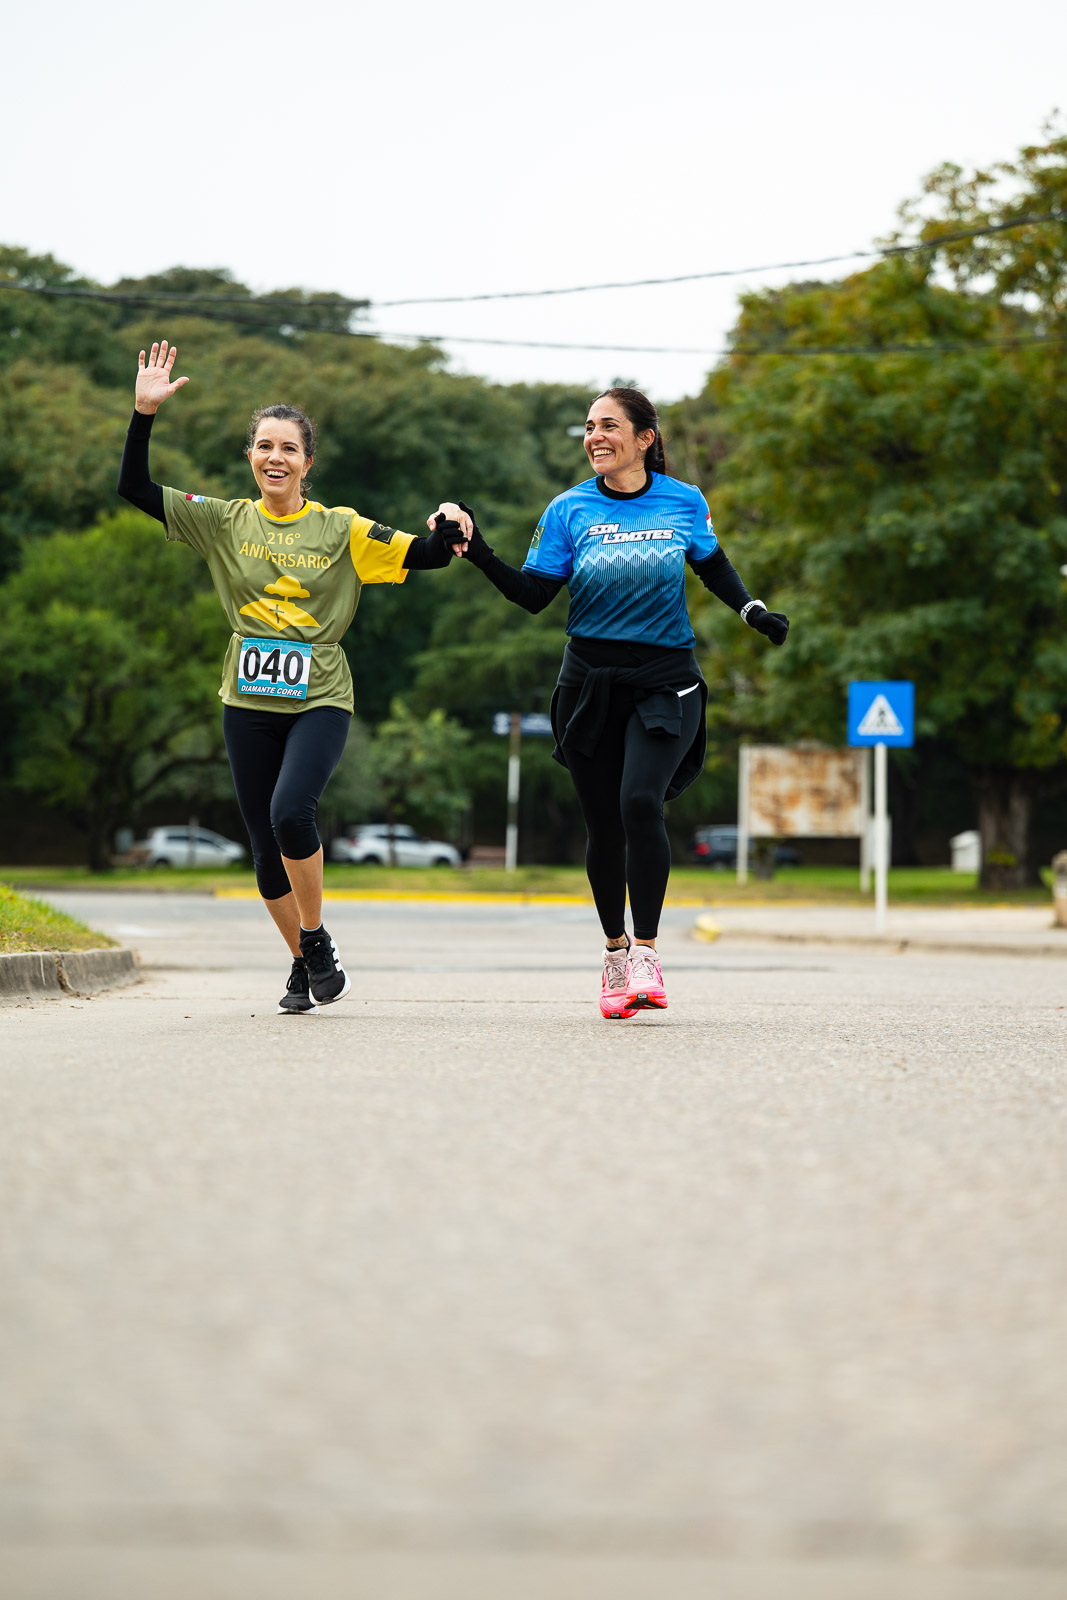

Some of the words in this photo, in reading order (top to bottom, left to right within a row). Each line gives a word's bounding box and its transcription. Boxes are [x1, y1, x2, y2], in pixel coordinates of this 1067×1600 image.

[588, 523, 620, 536] SIN
[601, 529, 675, 545] LIMITES
[267, 532, 300, 546] 216°
[239, 541, 331, 569] ANIVERSARIO
[243, 646, 304, 687] 040
[241, 685, 276, 694] DIAMANTE
[276, 687, 303, 697] CORRE
